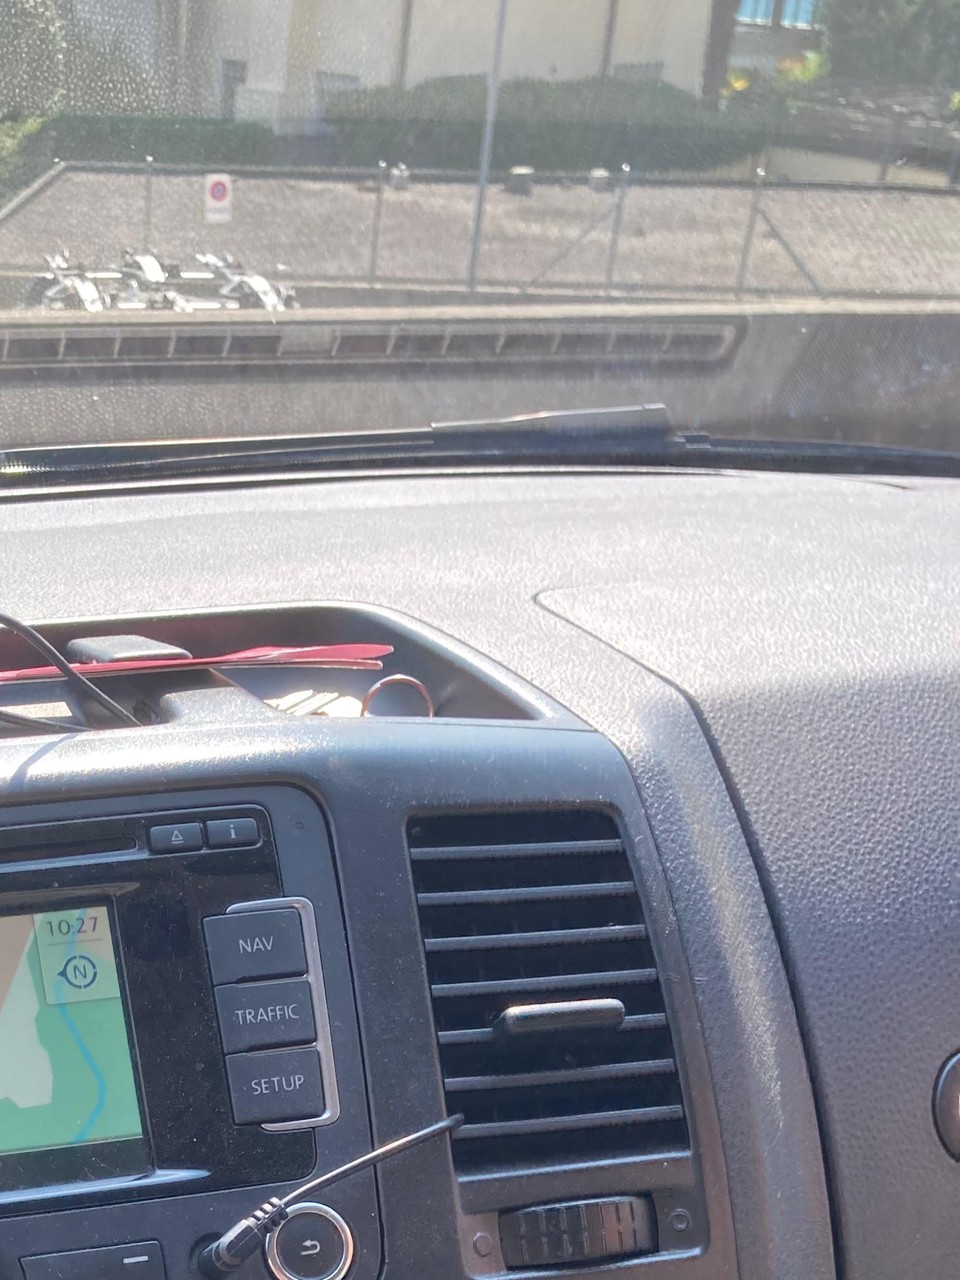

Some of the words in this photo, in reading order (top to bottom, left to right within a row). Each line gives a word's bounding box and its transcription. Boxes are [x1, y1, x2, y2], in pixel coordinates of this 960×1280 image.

[46, 916, 99, 937] 10:27
[238, 936, 274, 953] NAV
[71, 963, 87, 980] N
[235, 1004, 300, 1025] TRAFFIC
[251, 1075, 305, 1095] SETUP
